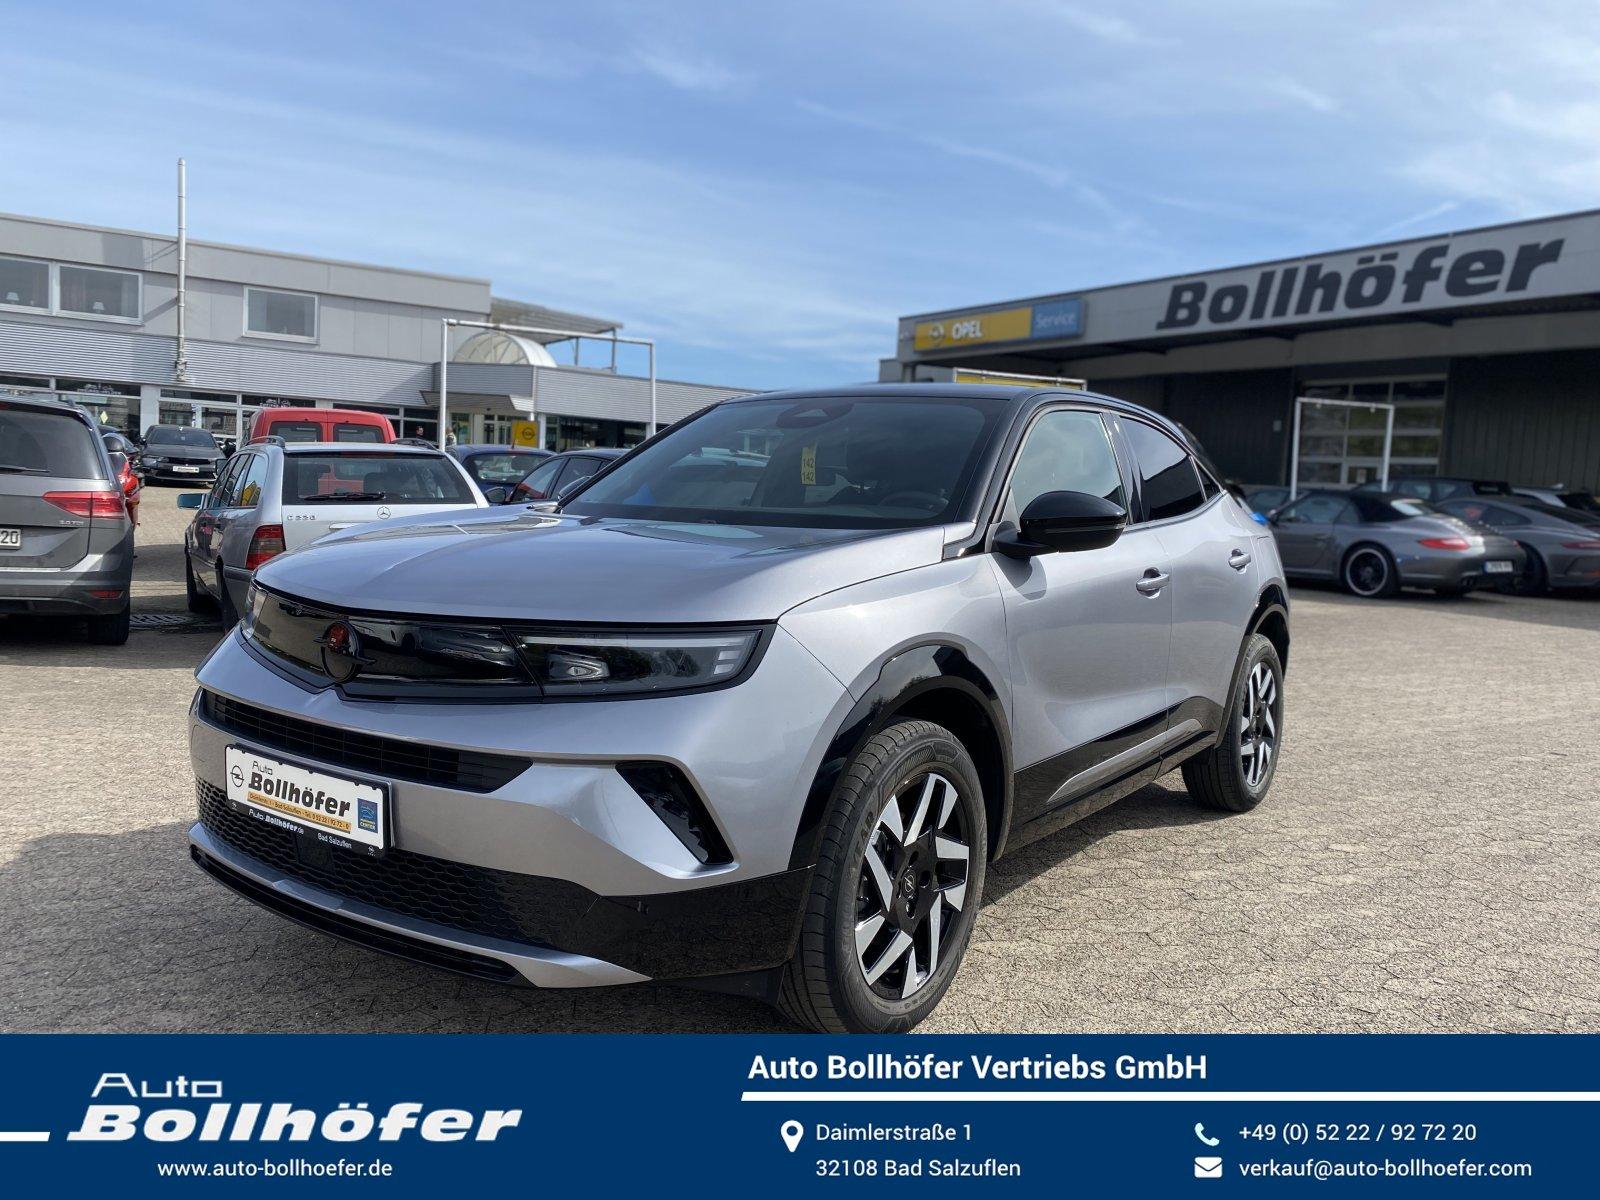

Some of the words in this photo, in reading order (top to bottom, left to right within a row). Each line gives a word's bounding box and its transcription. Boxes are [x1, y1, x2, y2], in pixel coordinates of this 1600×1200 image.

[1155, 237, 1566, 331] Bollhöfer
[952, 320, 983, 340] OPEL
[1035, 311, 1076, 329] Service
[802, 457, 815, 469] 142
[802, 471, 815, 482] 142
[252, 760, 273, 776] Auto
[248, 771, 351, 818] Bollhöfer
[317, 832, 328, 842] Bad
[328, 835, 353, 849] Salzuflen
